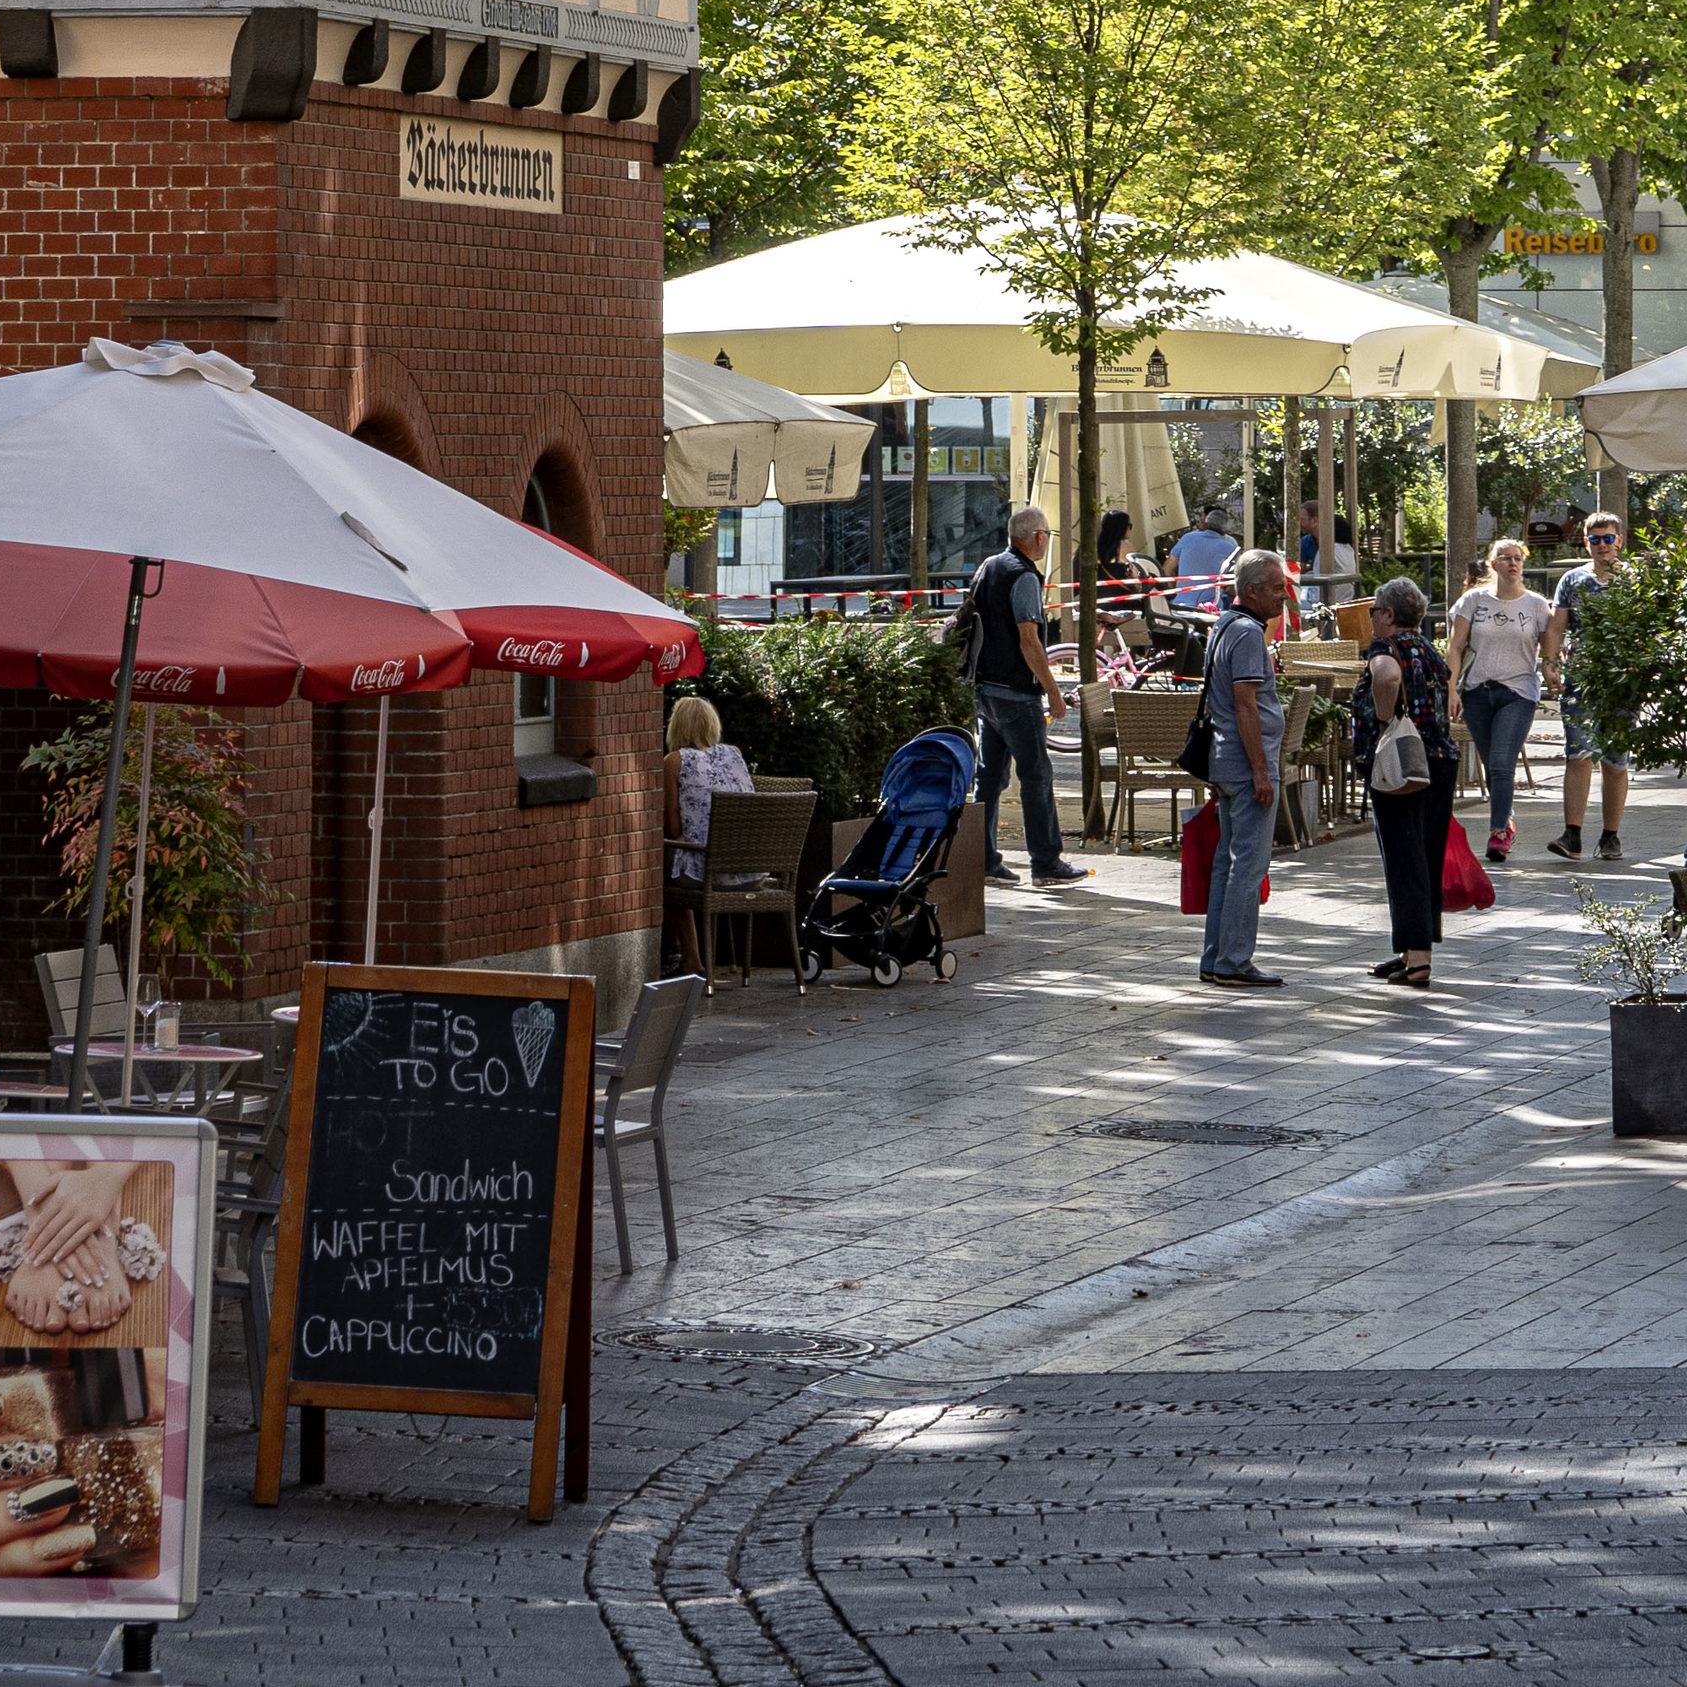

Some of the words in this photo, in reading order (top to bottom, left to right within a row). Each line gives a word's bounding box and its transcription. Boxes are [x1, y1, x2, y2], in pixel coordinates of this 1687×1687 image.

[406, 118, 555, 202] Bäckerbrunnen
[496, 636, 567, 668] Coca-Cola
[351, 658, 407, 692] Coca-Cola
[379, 1058, 437, 1090] TO
[451, 1057, 510, 1097] GO
[386, 1158, 533, 1203] Sandwich
[312, 1220, 438, 1261] WAFFEL
[465, 1222, 529, 1254] MIT
[341, 1253, 514, 1294] APFELMUS
[302, 1314, 498, 1362] CAPPUCCINO
